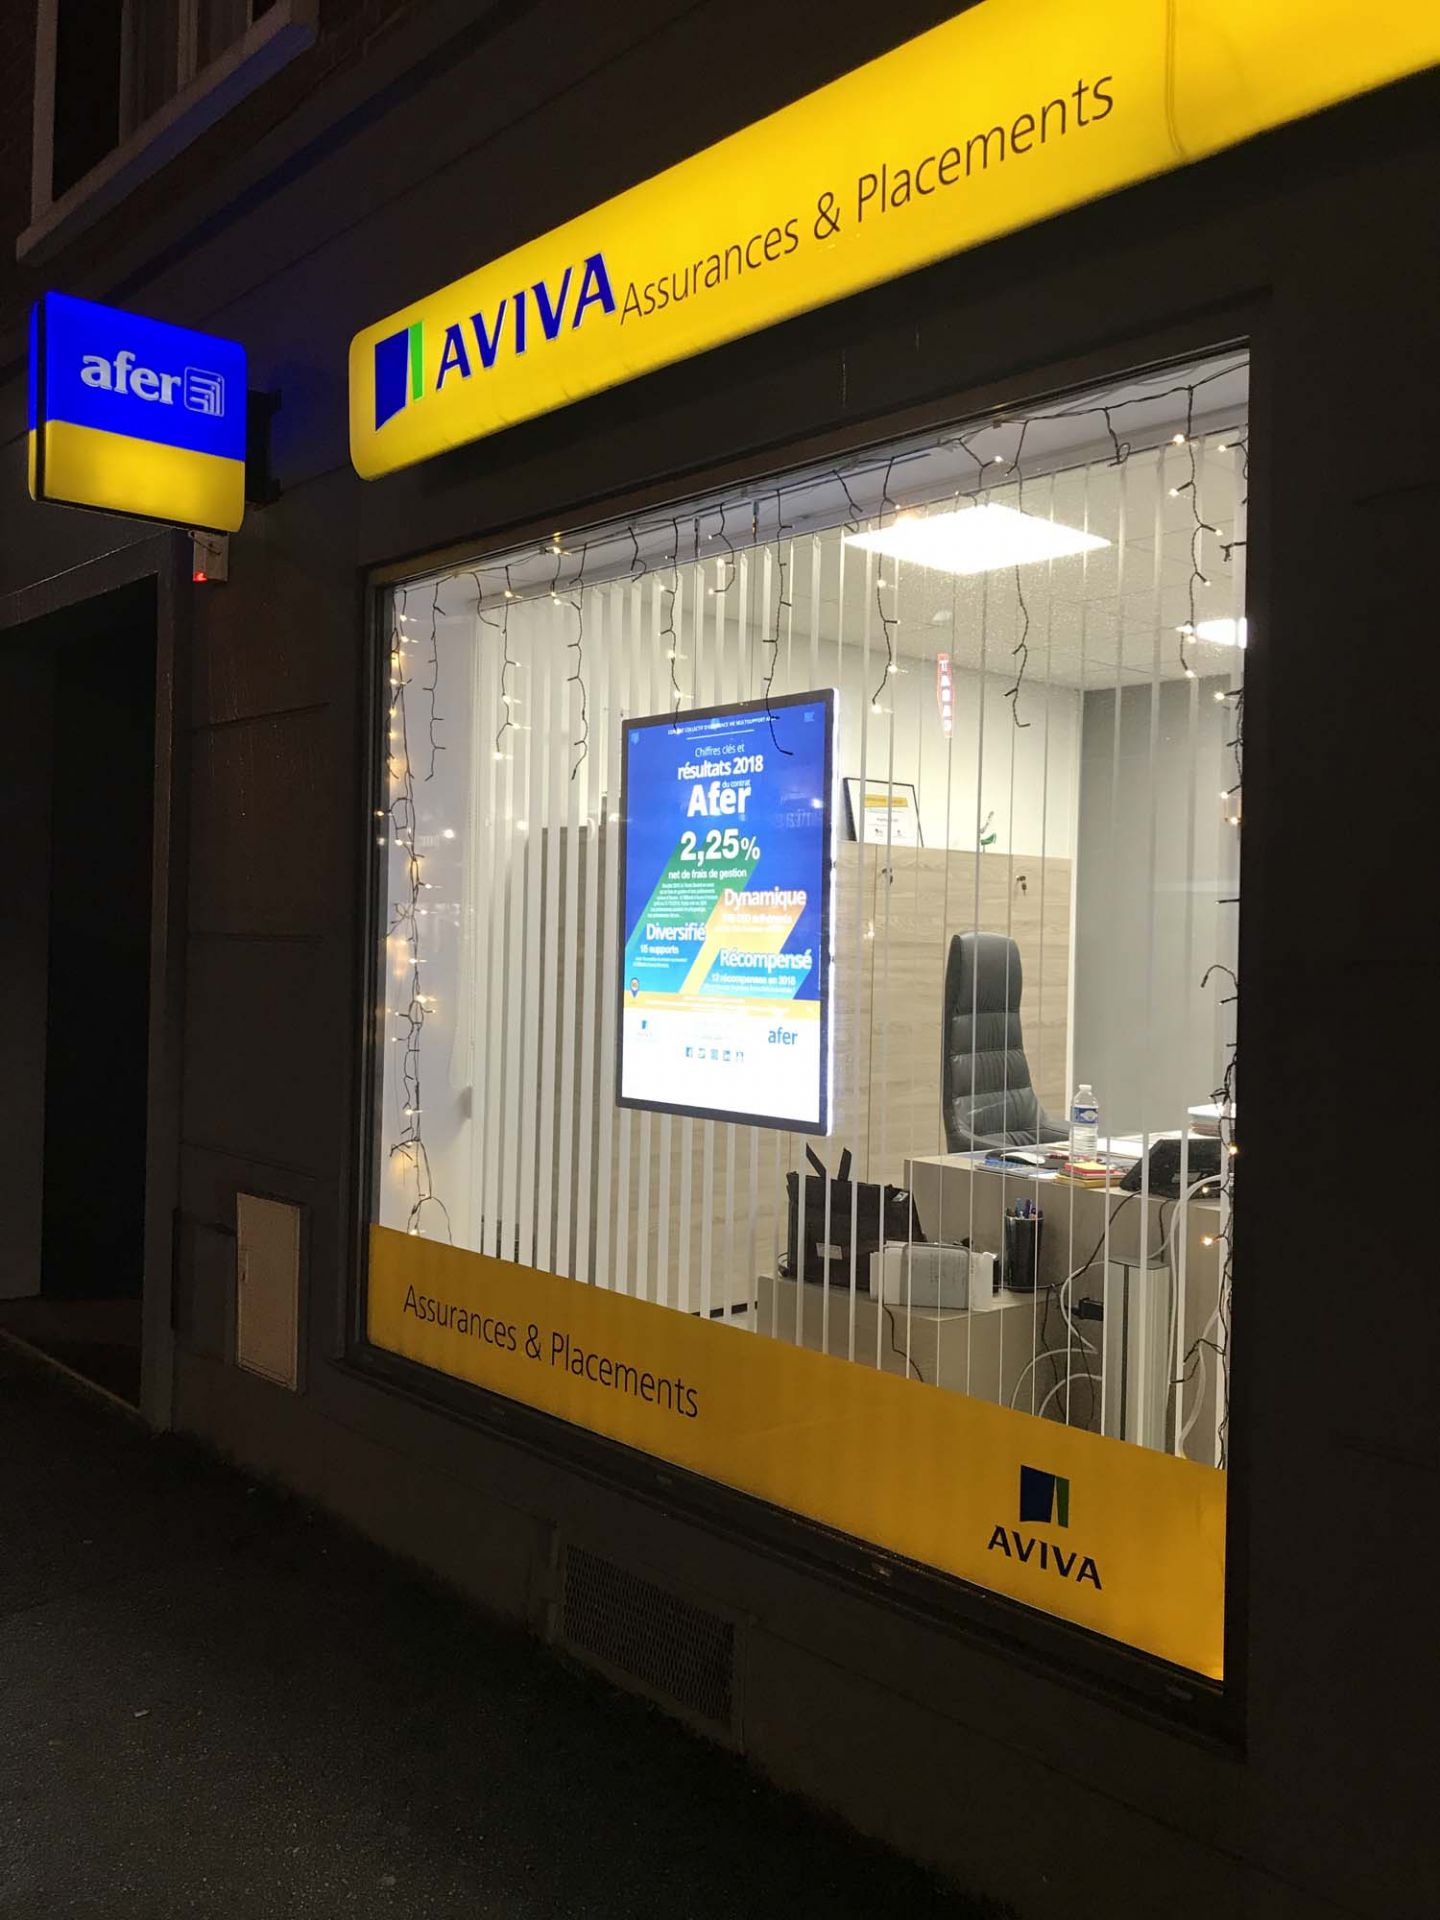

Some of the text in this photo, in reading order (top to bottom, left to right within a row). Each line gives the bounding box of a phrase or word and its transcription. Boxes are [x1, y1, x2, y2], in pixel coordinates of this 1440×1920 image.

[620, 75, 1115, 326] Assurances & Placements
[435, 251, 617, 391] AVIVA
[80, 350, 182, 405] afer
[695, 744, 745, 757] Chiffres clés et
[678, 754, 764, 780] résultats 2018
[687, 781, 751, 817] Afer
[668, 867, 747, 880] net de frais de gestion
[724, 886, 807, 911] Dynamique
[646, 922, 706, 940] Diversifié
[720, 948, 813, 974] Récompensé
[768, 1027, 798, 1045] afer
[403, 1284, 699, 1418] Assurances & Placements
[987, 1524, 1103, 1590] AVIVA
